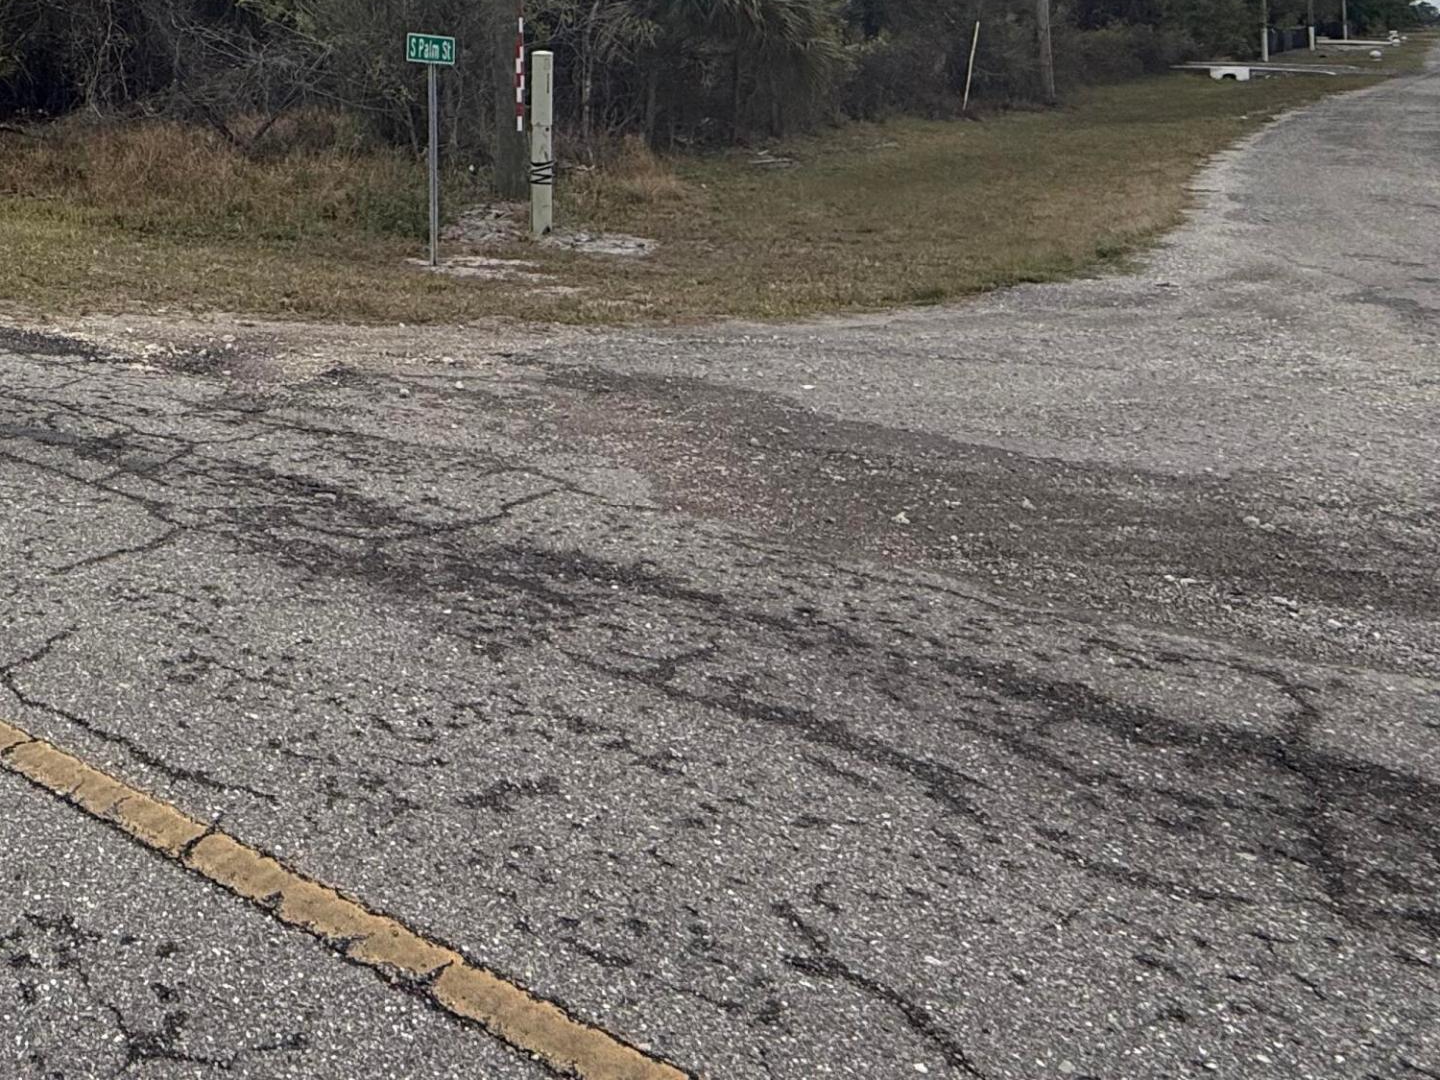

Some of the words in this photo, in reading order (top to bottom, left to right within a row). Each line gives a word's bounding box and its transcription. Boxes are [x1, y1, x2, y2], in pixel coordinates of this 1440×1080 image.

[410, 37, 417, 57] S
[418, 38, 440, 59] Palm
[442, 40, 451, 61] St
